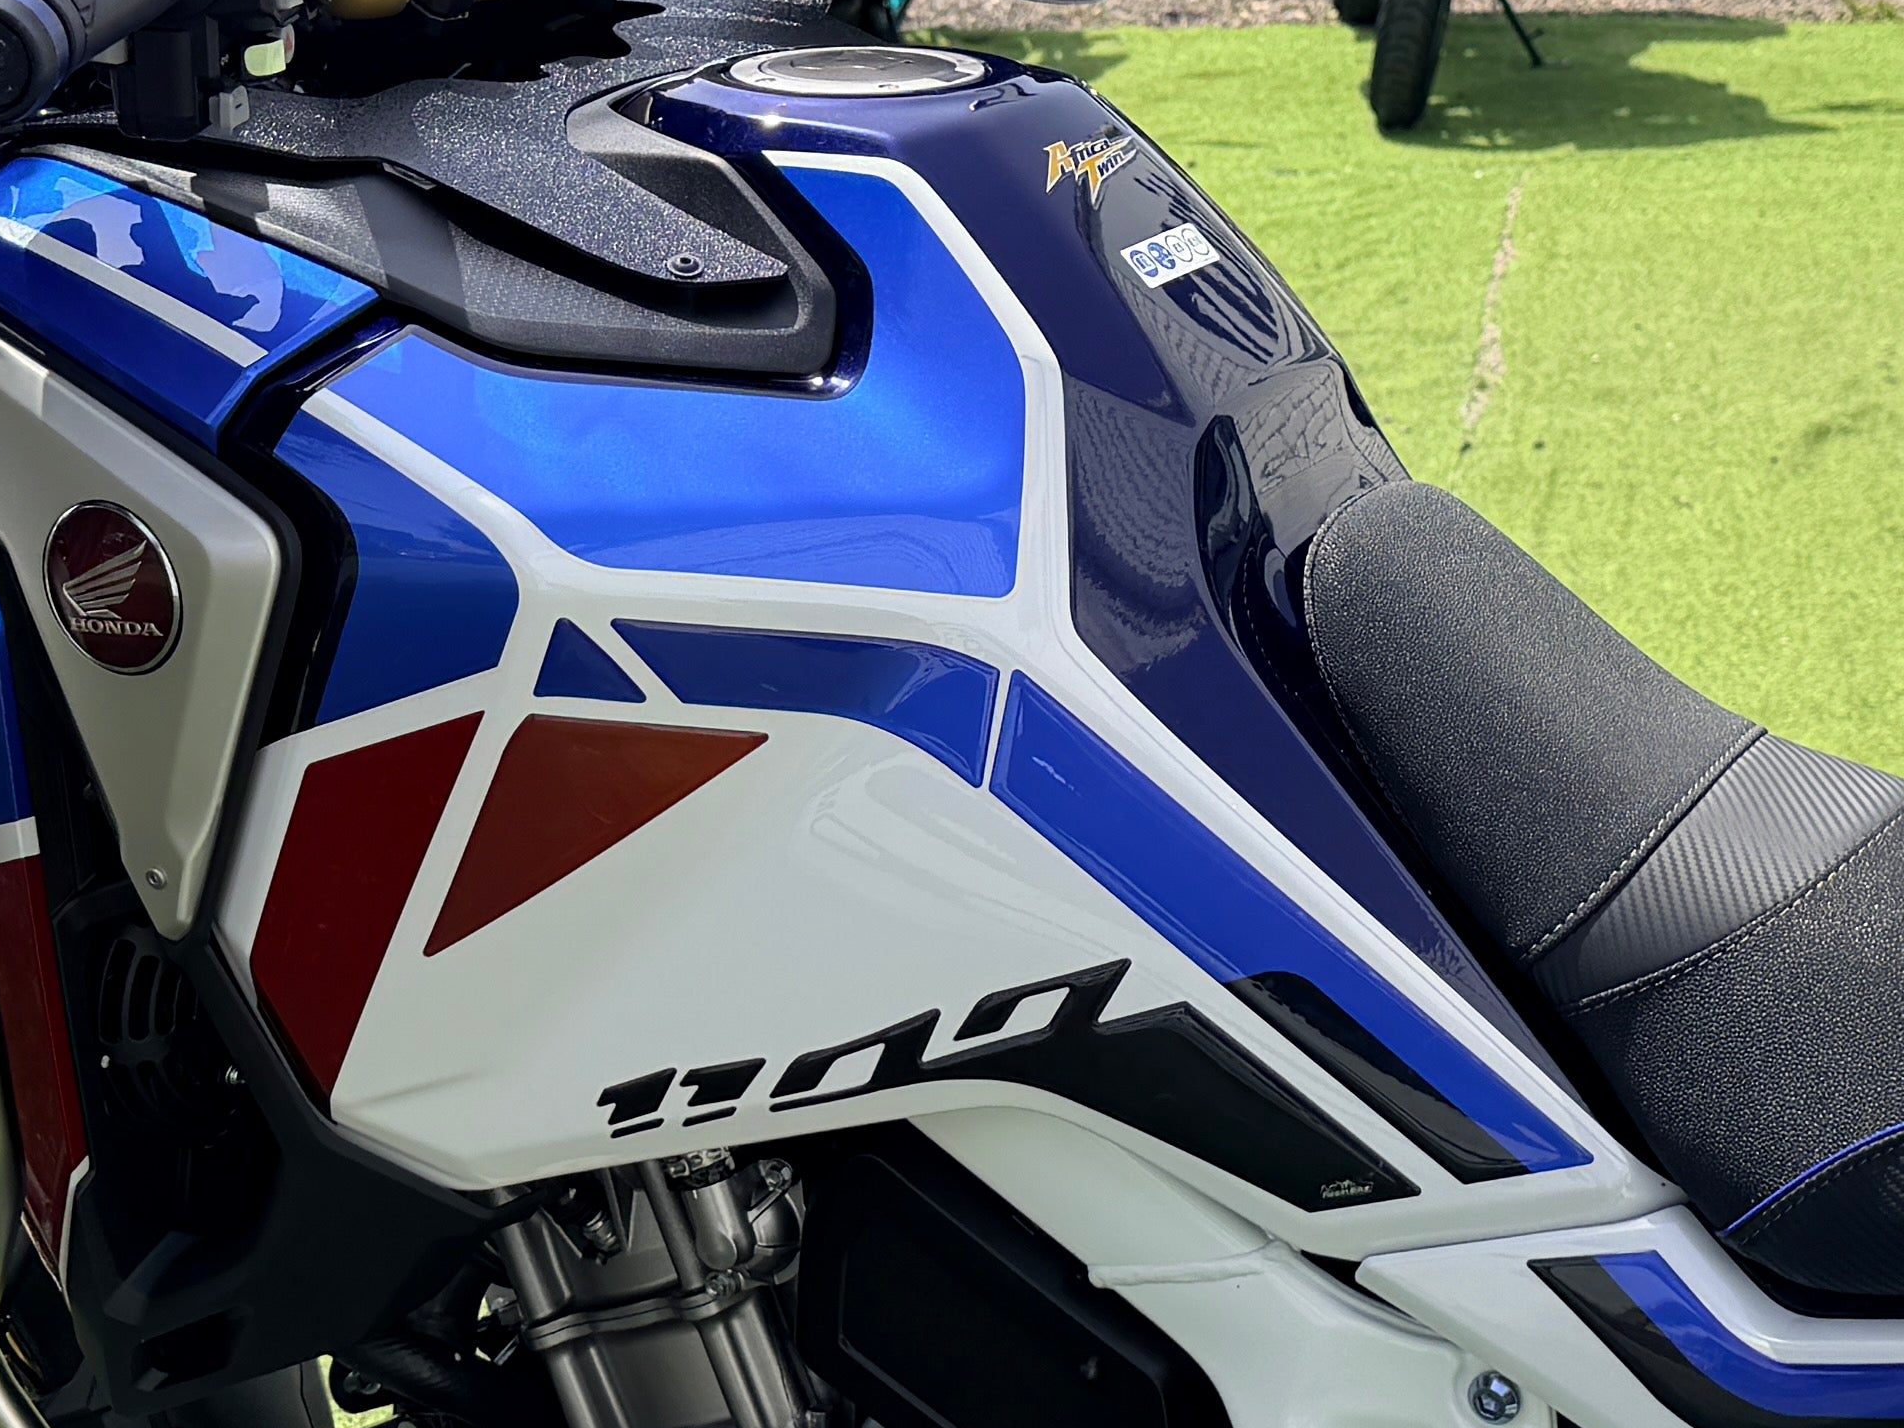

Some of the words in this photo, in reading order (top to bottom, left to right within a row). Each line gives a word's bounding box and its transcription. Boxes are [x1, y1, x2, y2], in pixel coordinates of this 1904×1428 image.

[1043, 138, 1112, 193] Africa
[1076, 144, 1136, 206] Twin
[70, 616, 164, 637] HONDA
[597, 958, 1132, 1139] 1100
